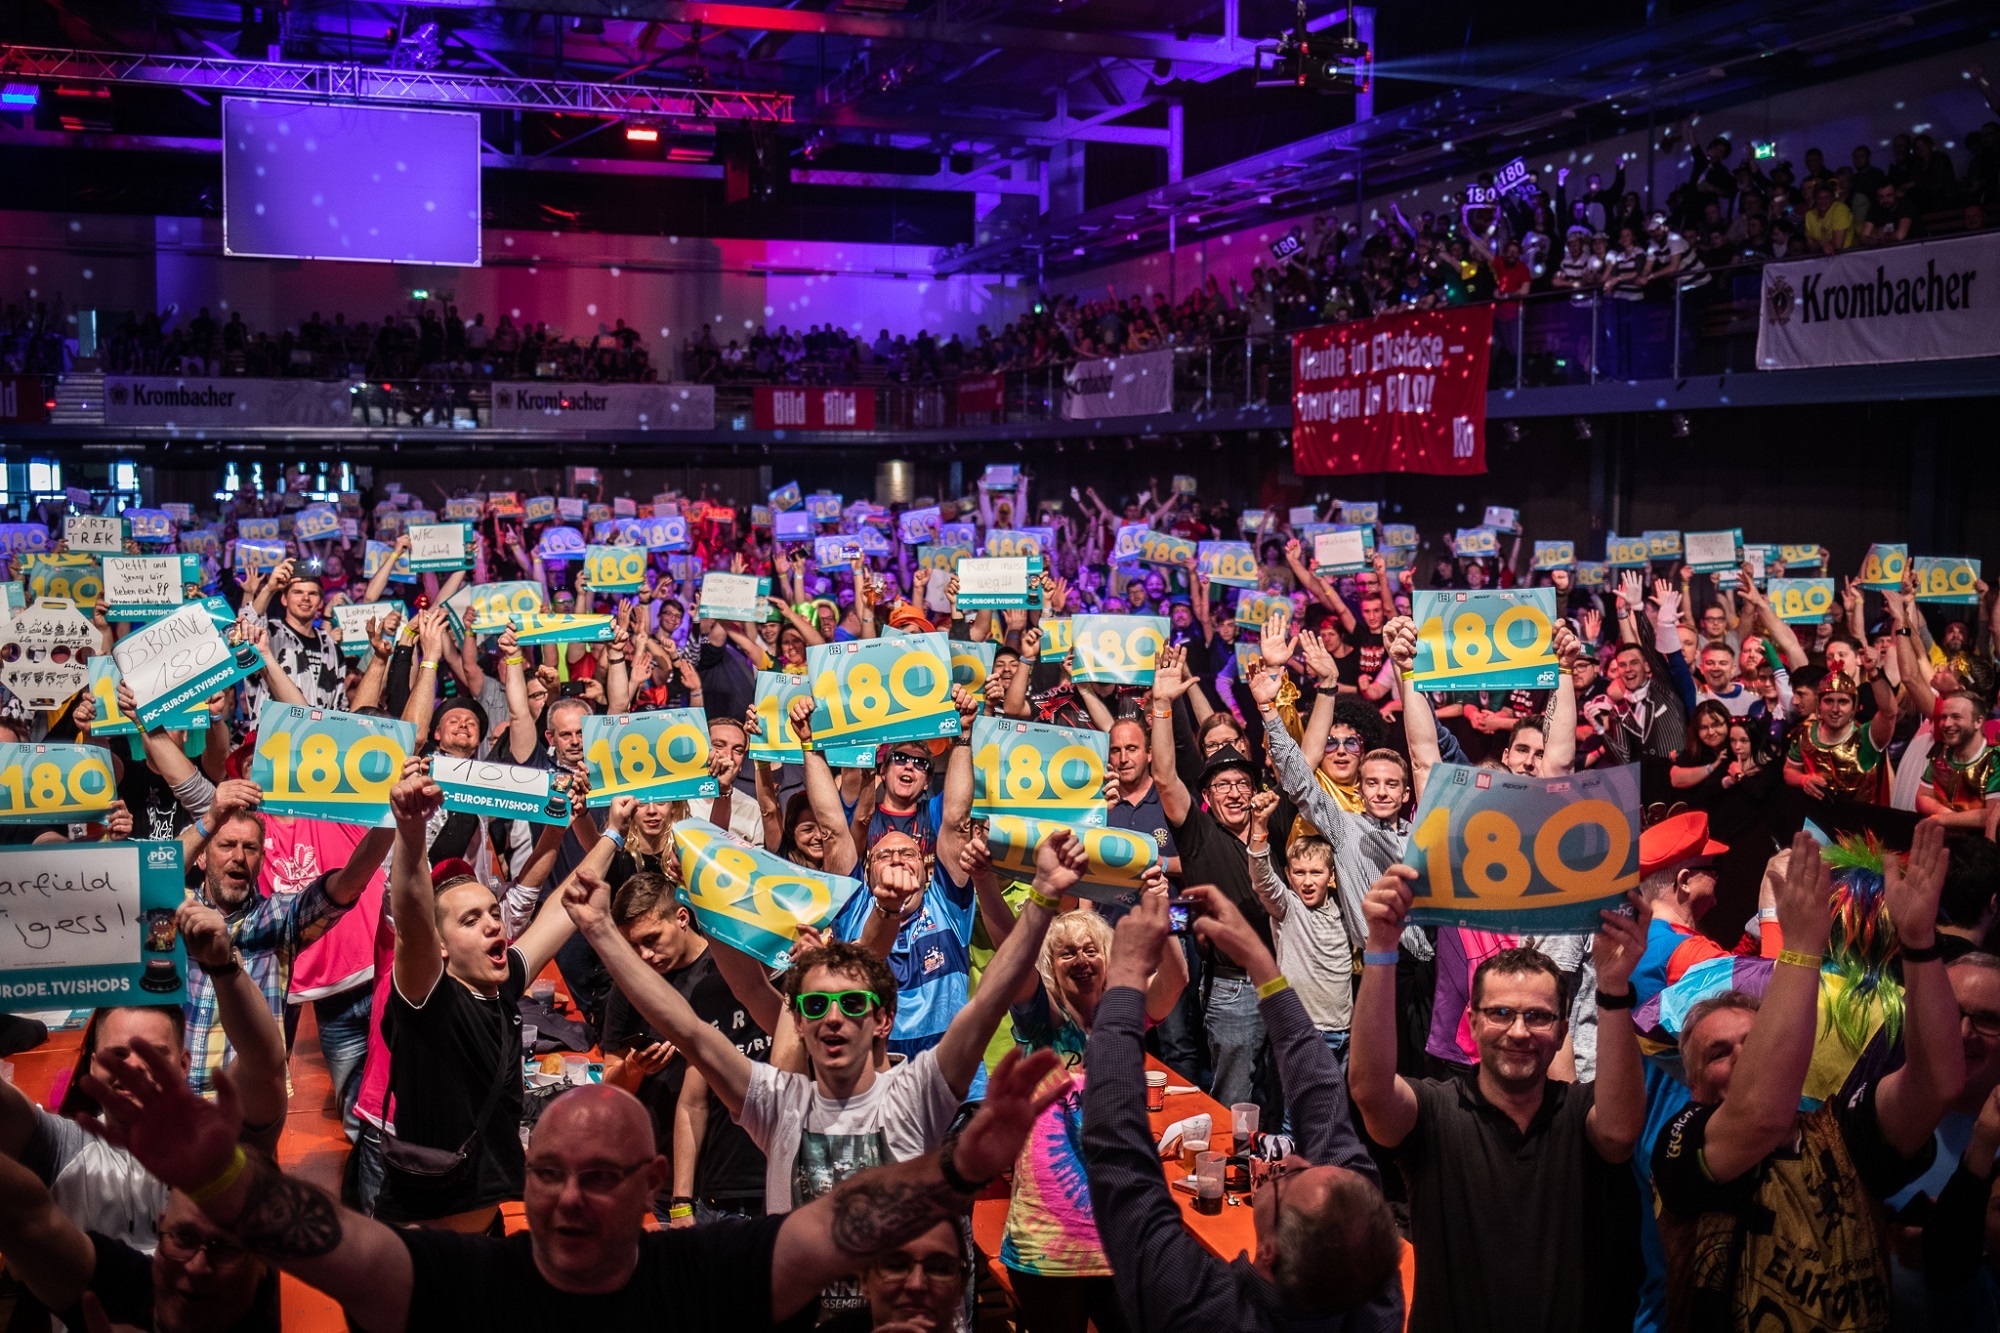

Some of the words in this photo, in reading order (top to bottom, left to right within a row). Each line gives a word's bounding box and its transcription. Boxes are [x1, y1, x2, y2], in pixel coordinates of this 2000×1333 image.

[1499, 161, 1525, 185] 180
[1466, 187, 1496, 203] 180
[1273, 235, 1298, 256] 180
[1802, 259, 1976, 323] Krombacher
[1351, 340, 1367, 375] in
[1372, 330, 1443, 371] Ekstase
[133, 384, 235, 407] Krombacher
[516, 389, 608, 413] Krombacher
[773, 390, 806, 425] Bild
[823, 391, 856, 425] Bild
[1364, 381, 1381, 416] in
[1386, 374, 1435, 413] BILD!
[299, 511, 338, 537] 180
[904, 513, 940, 538] 180
[1344, 506, 1377, 524] 180
[1, 529, 49, 552] 180
[241, 523, 278, 539] 180
[541, 532, 582, 552] 180
[643, 521, 686, 545] 180
[1385, 527, 1415, 546] 180
[1459, 533, 1496, 552] 180
[237, 546, 283, 567] 180
[988, 537, 1040, 557] 180
[1143, 541, 1192, 564] 180
[1536, 545, 1573, 568] 180
[1609, 543, 1647, 563] 180
[1651, 536, 1679, 553] 80
[586, 554, 646, 584] 180
[1212, 553, 1258, 578] 180
[1866, 551, 1907, 582] 80
[32, 576, 104, 607] 180
[1918, 566, 1977, 596] 180
[472, 588, 542, 625] 180
[1238, 598, 1291, 623] 180
[1770, 585, 1834, 617] 180
[115, 606, 213, 674] OSBORNE
[1073, 627, 1166, 671] 180
[1419, 605, 1552, 672] 180
[153, 641, 217, 696] 180
[142, 666, 235, 724] PDC-EUROPE.TV/SHOPS
[813, 651, 950, 727] 180
[259, 731, 406, 796] 180
[587, 724, 709, 793] 180
[0, 758, 114, 811] 180
[973, 744, 1106, 802] 180
[442, 790, 539, 814] C-EUROPE.TV/SHOPS
[149, 850, 175, 862] PDC
[1414, 799, 1631, 899] 180
[678, 829, 832, 926] 180
